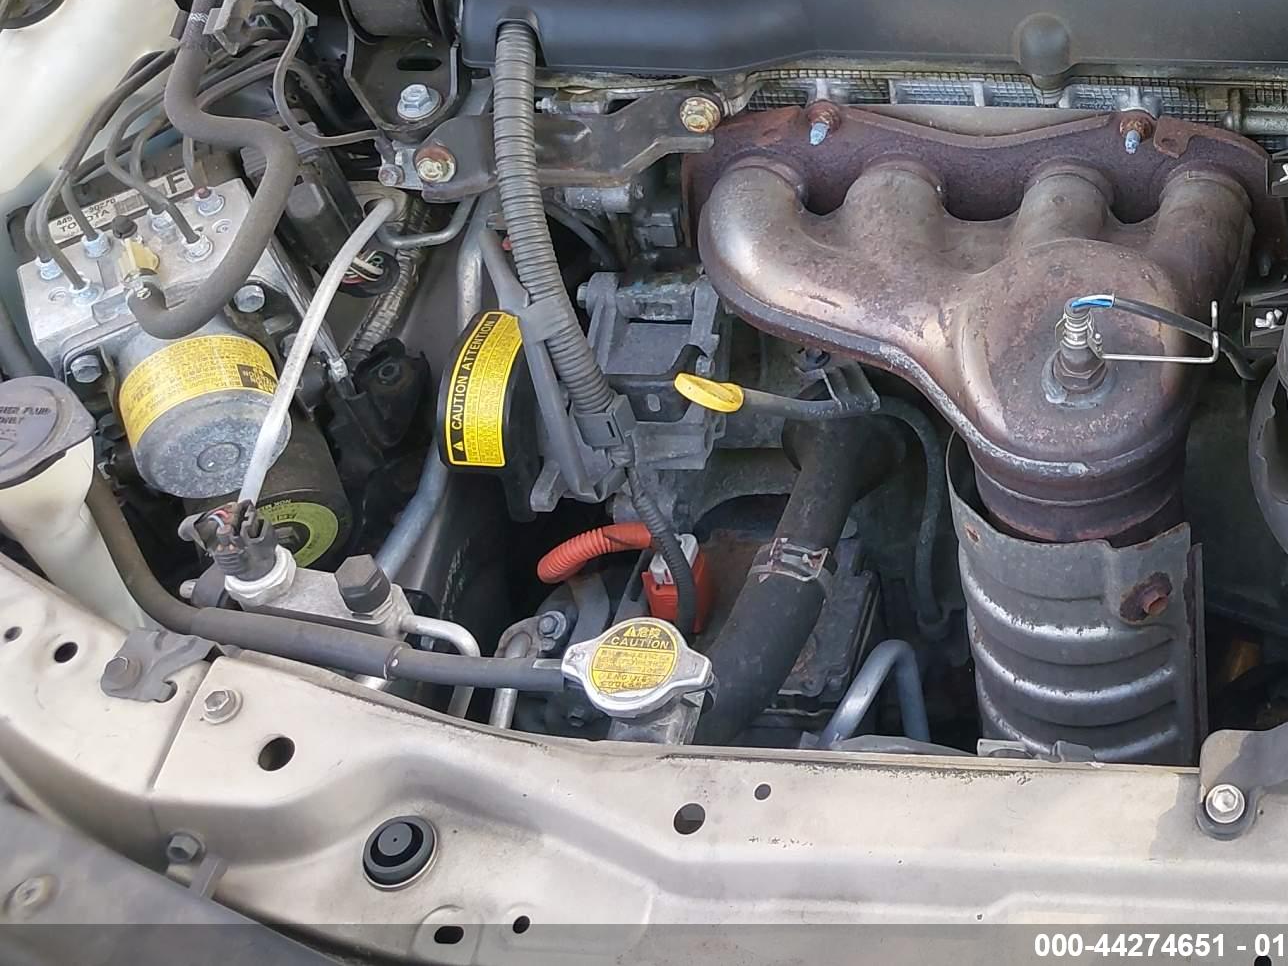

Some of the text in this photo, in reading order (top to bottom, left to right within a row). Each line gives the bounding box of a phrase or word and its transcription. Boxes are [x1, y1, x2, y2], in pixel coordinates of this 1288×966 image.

[165, 170, 186, 194] F
[60, 210, 111, 233] TOOTA
[451, 375, 468, 431] CAUTION
[461, 320, 496, 371] ATTENTION
[611, 636, 671, 650] CAUTION
